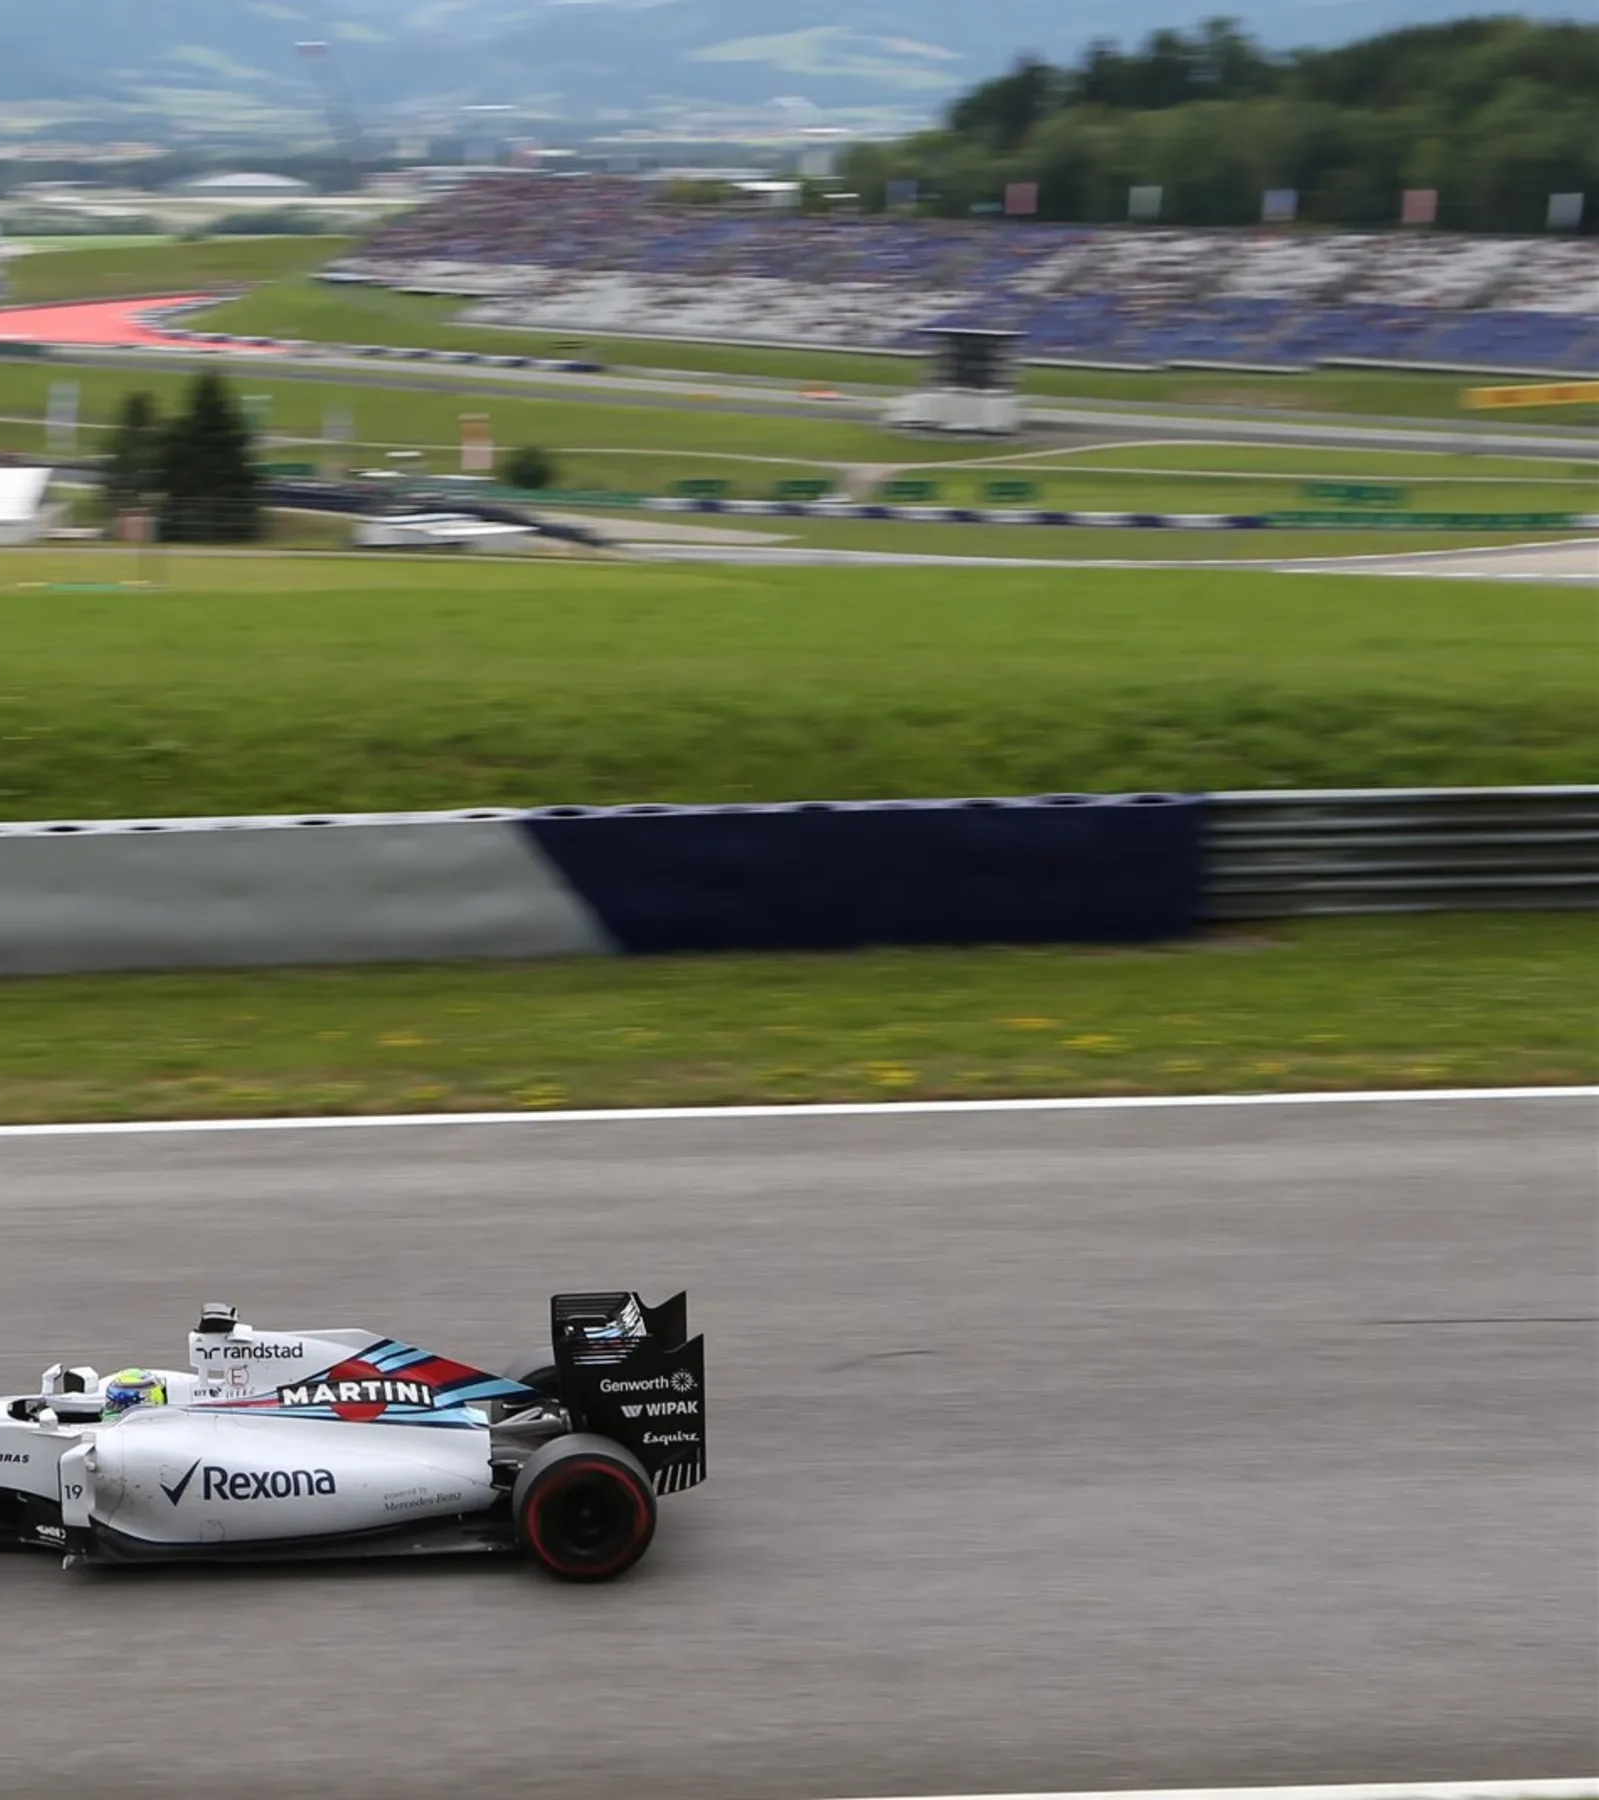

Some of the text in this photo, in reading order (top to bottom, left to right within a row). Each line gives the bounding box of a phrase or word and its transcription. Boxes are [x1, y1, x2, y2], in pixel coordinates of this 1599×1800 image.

[223, 1342, 303, 1360] randstad
[600, 1376, 669, 1392] Genworth
[282, 1380, 431, 1406] MARTINI
[646, 1401, 698, 1416] WIPAK
[642, 1432, 699, 1445] Esquire
[203, 1466, 336, 1501] Rexona
[65, 1485, 83, 1499] 19
